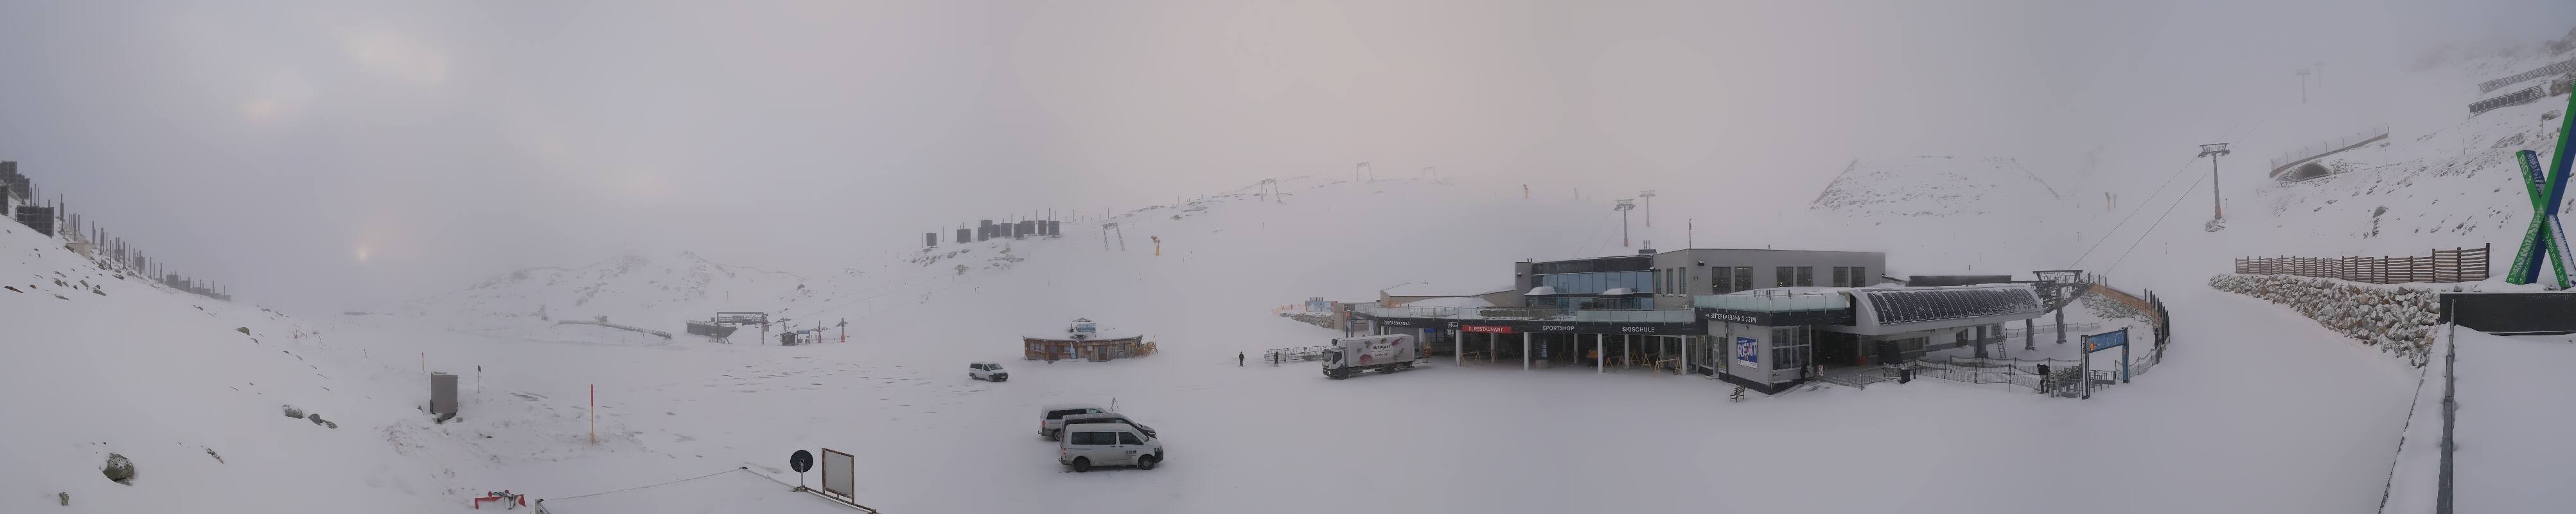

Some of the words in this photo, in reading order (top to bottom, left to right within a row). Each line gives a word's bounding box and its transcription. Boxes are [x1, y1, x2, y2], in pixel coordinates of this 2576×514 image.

[2519, 154, 2528, 175] BIG
[2526, 175, 2532, 184] 3
[1738, 342, 1757, 357] RENT
